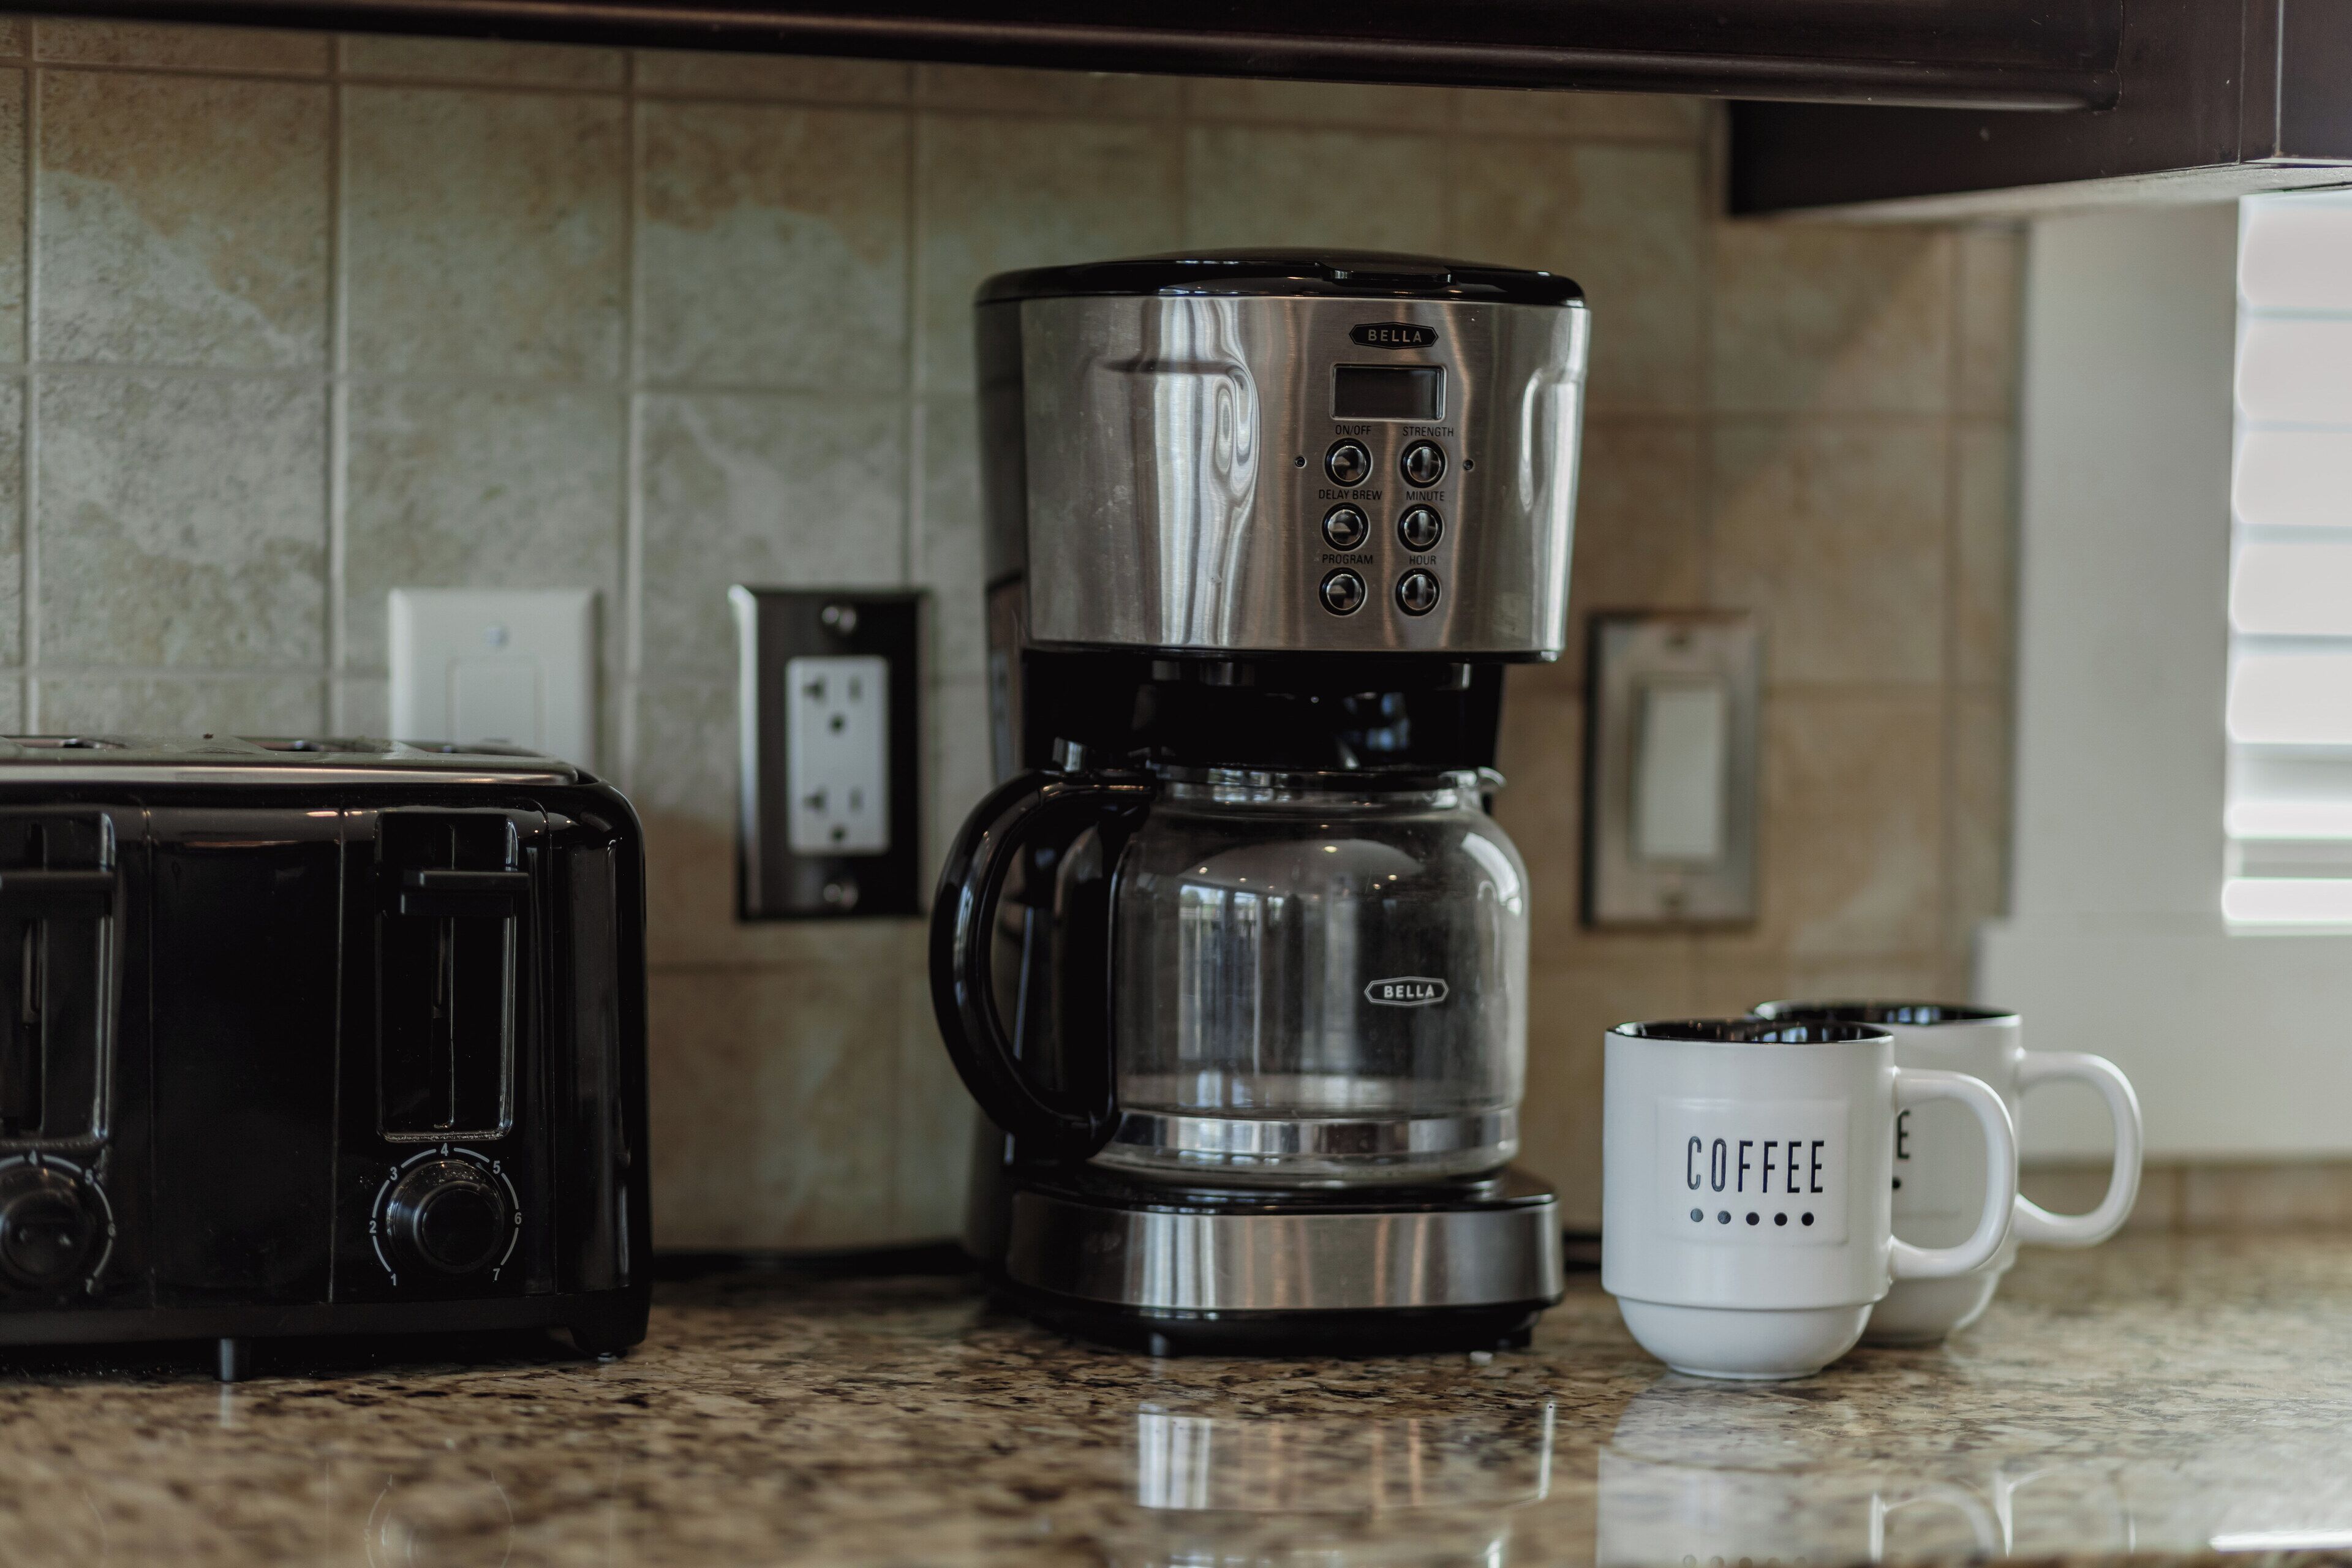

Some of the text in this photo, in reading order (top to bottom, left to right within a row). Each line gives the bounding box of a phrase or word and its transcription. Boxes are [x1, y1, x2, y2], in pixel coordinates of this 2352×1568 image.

[1368, 330, 1422, 342] BELLA
[1335, 424, 1371, 435] ON/OFF
[1403, 426, 1453, 437] STRENGTH
[1319, 489, 1382, 500] DELAY BREW
[1406, 491, 1445, 500] MINUTE
[1322, 554, 1373, 564] PROGRAM
[1409, 555, 1436, 565] HOUR
[1383, 984, 1435, 998] BELLA
[1686, 1135, 1825, 1194] COFFEE
[369, 1142, 521, 1286] 1 2 3 4 5 6 7
